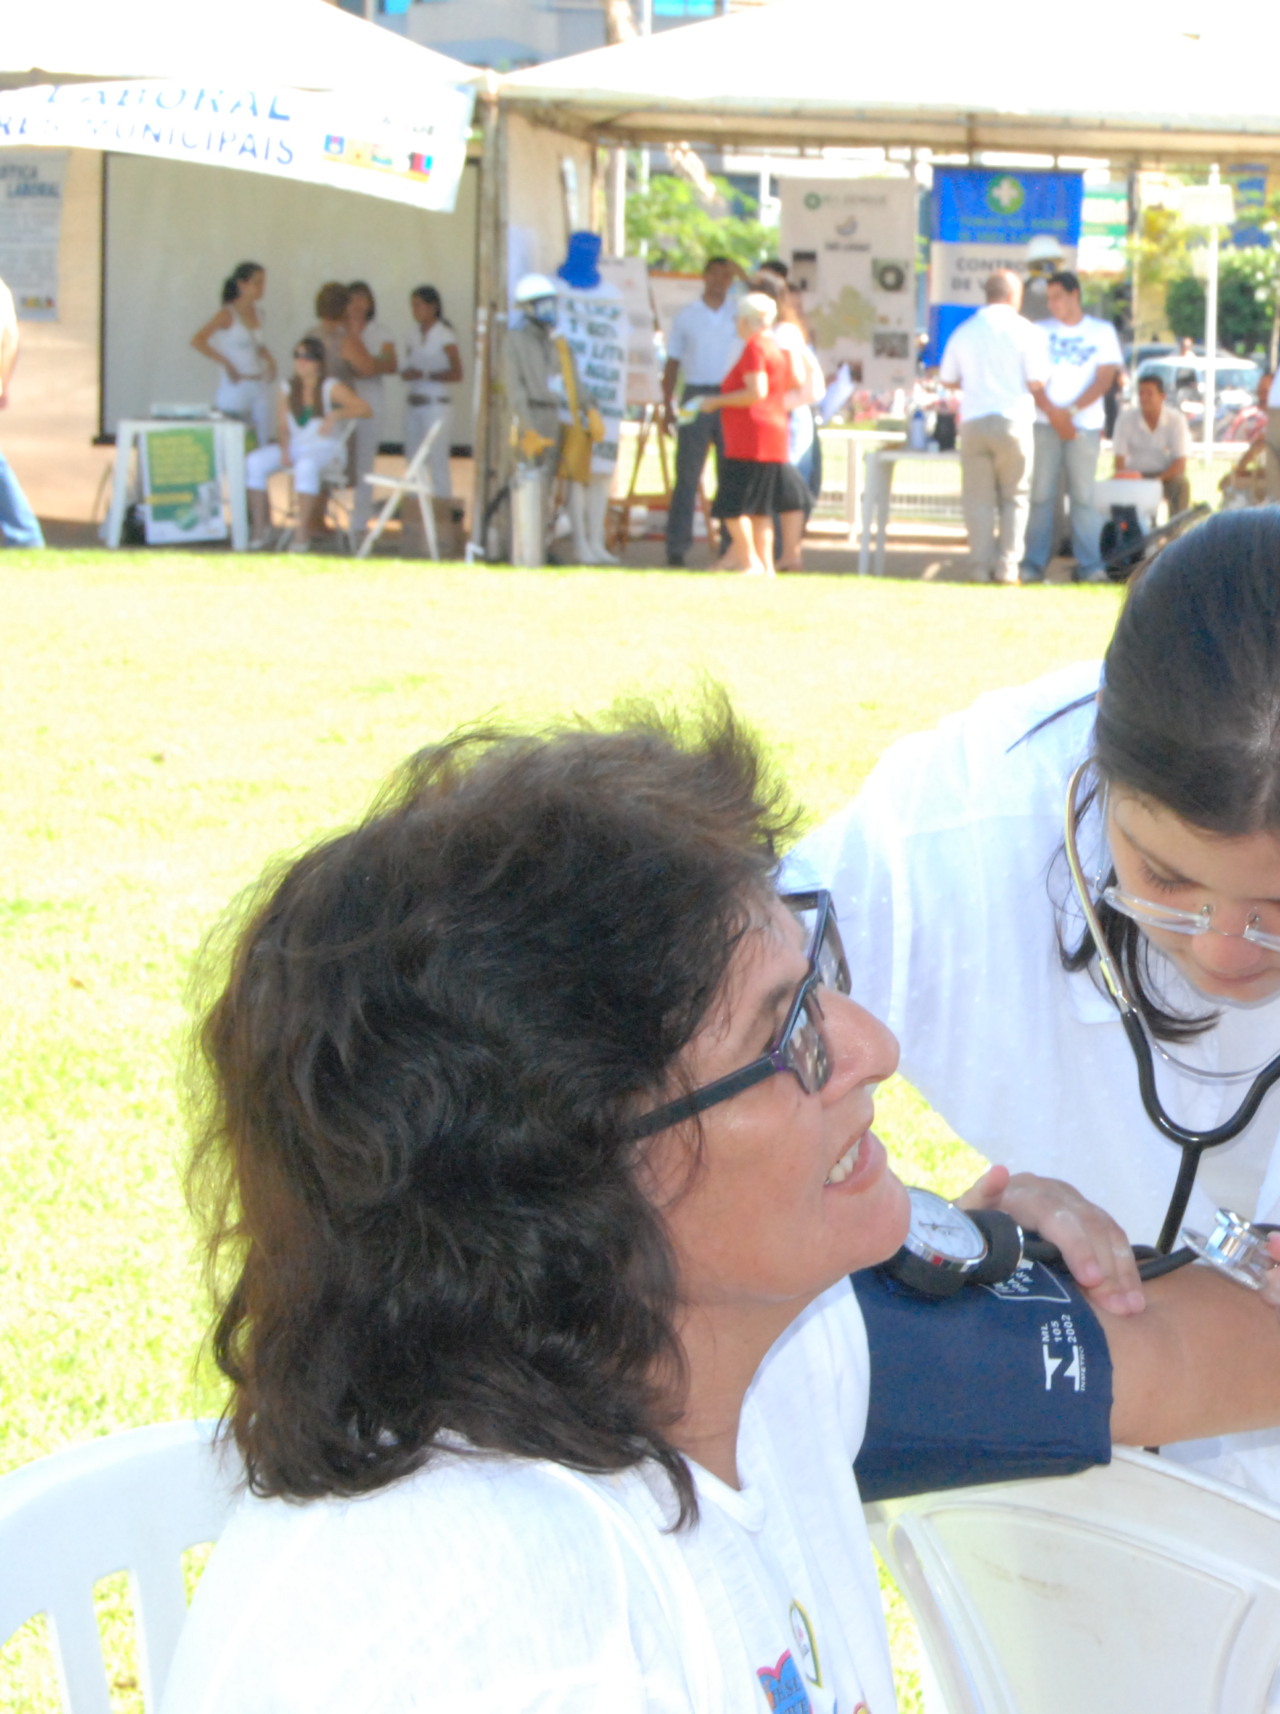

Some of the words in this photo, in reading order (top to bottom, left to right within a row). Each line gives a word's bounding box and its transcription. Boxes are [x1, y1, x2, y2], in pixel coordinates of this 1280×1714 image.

[1041, 1322, 1050, 1343] ML
[1050, 1320, 1063, 1343] 105
[1061, 1313, 1078, 1344] 2002
